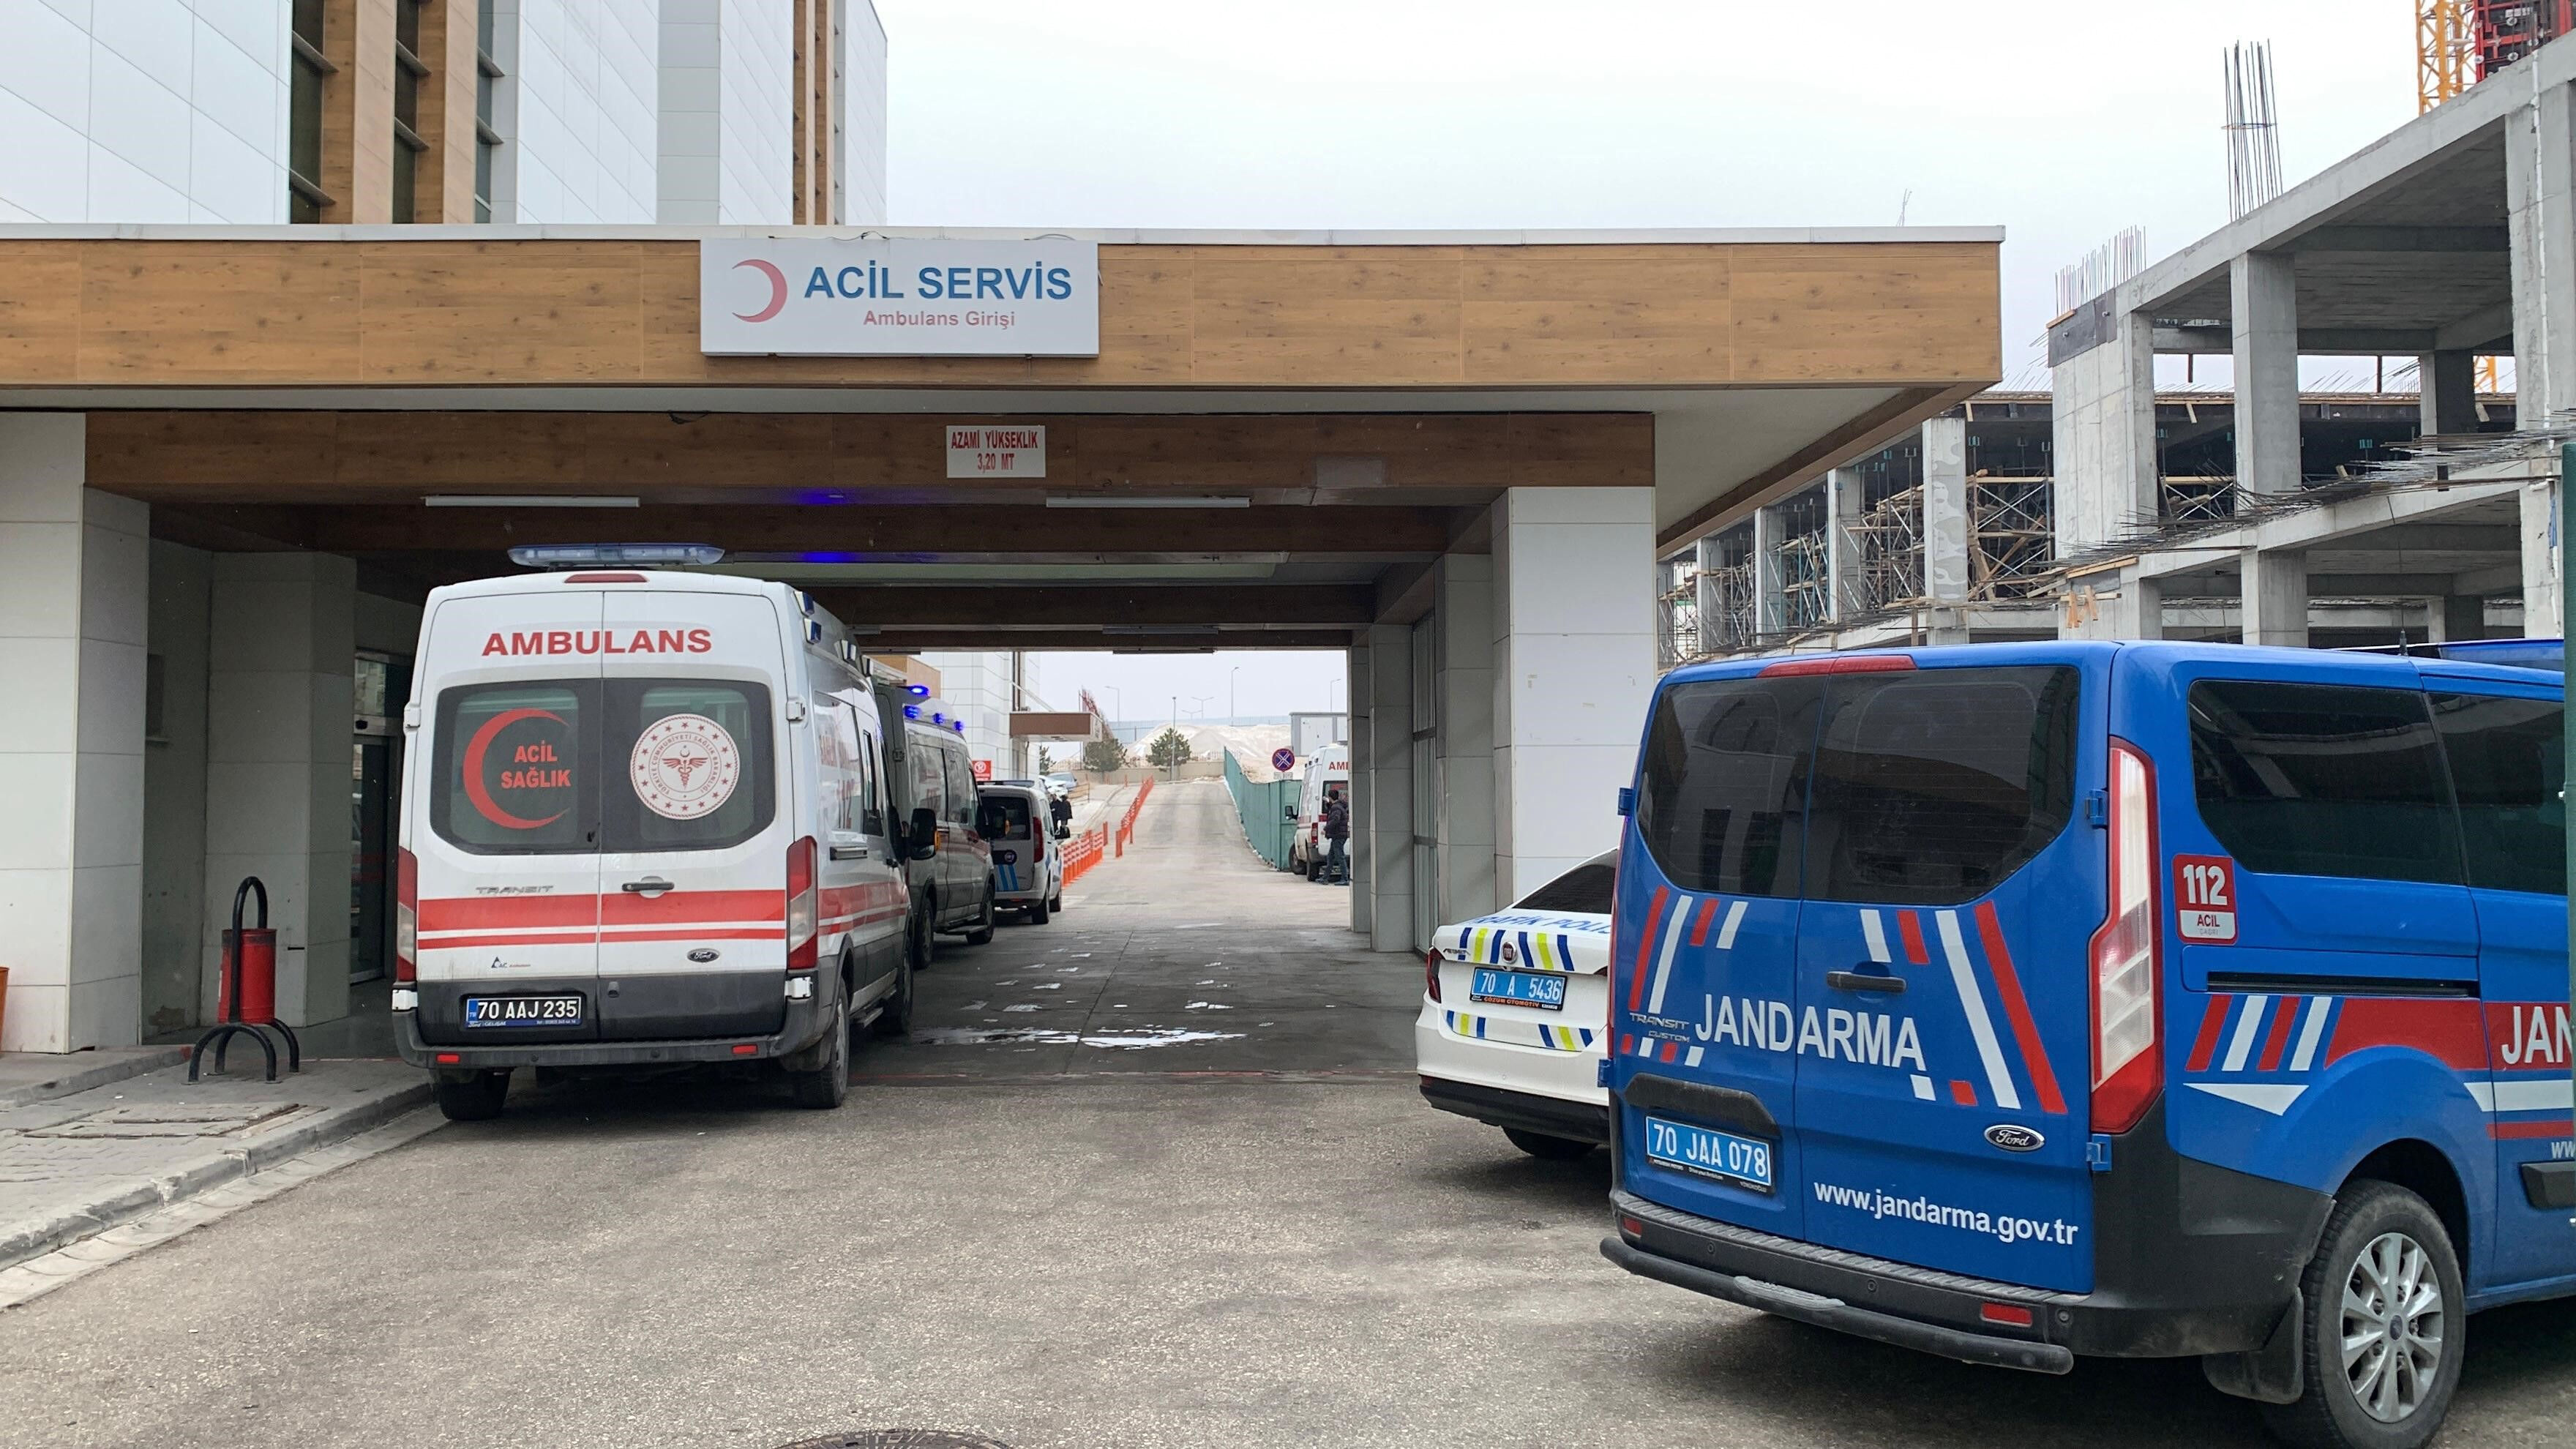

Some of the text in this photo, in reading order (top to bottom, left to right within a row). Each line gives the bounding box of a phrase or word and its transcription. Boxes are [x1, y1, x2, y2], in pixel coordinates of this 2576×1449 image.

[804, 260, 1072, 300] ACİL SERVİS
[863, 310, 1016, 330] Ambulans Girişi
[951, 430, 1038, 449] AZAMİ YÜKSEKLİK
[977, 452, 1014, 473] 3,20 MT
[482, 629, 713, 656] AMBULANS
[514, 739, 558, 763] ACİL
[1328, 761, 1349, 771] AM
[501, 766, 572, 789] SAĞLIK
[475, 885, 554, 894] TRANSIT
[2183, 864, 2228, 905] 112
[1480, 973, 1562, 1001] 70 A 5436
[478, 1000, 577, 1019] 70 AAJ 235
[1629, 1012, 1690, 1030] TRANSIT
[1648, 1030, 1690, 1042] CUSTOM
[1695, 994, 1927, 1072] JANDARMA
[1996, 1129, 2030, 1146] Ford
[1654, 1123, 1677, 1156] 70
[1686, 1132, 1723, 1167] JAA
[1729, 1141, 1767, 1177] 078
[1813, 1182, 2079, 1245] www.jandarma.gov.tr
